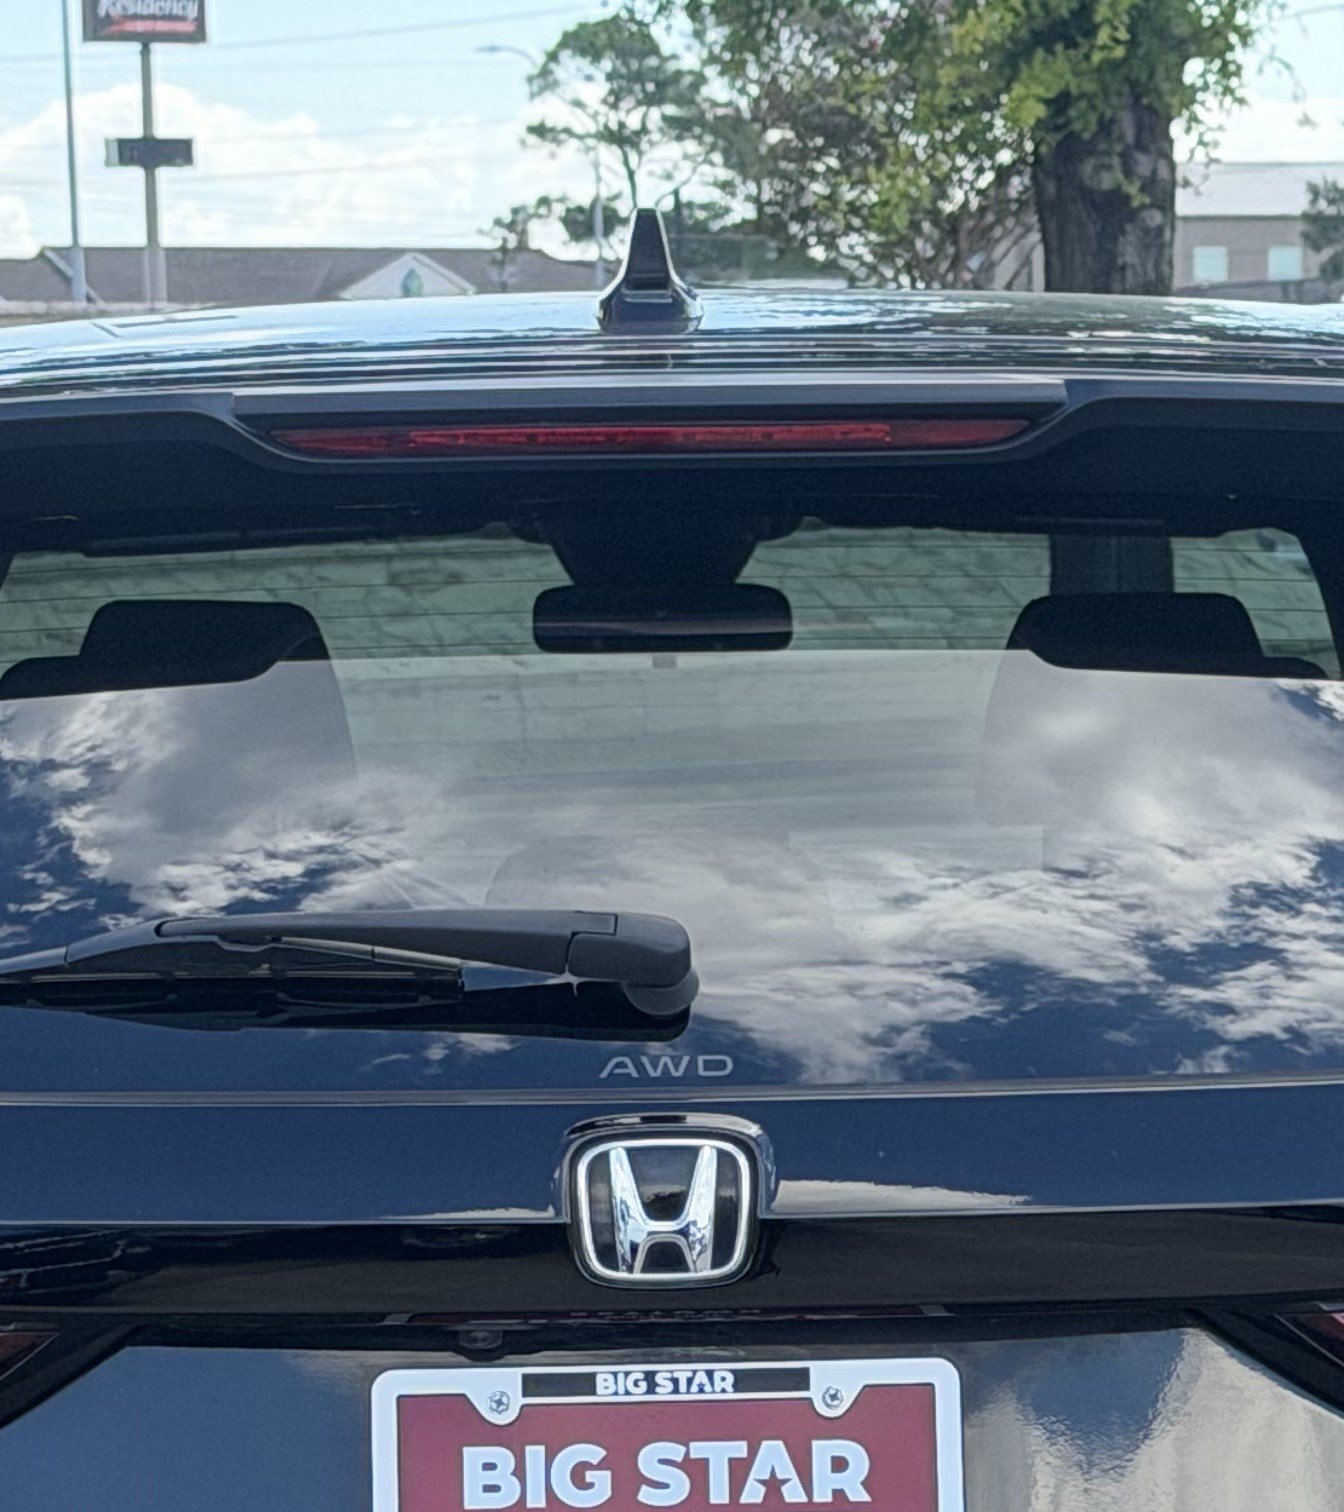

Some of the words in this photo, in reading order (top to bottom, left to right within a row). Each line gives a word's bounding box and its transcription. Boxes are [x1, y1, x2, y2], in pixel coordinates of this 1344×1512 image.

[599, 1055, 734, 1078] AWD
[595, 1372, 648, 1396] BIG
[655, 1369, 735, 1395] STAR
[462, 1442, 613, 1511] BIG
[636, 1439, 873, 1505] STAR
